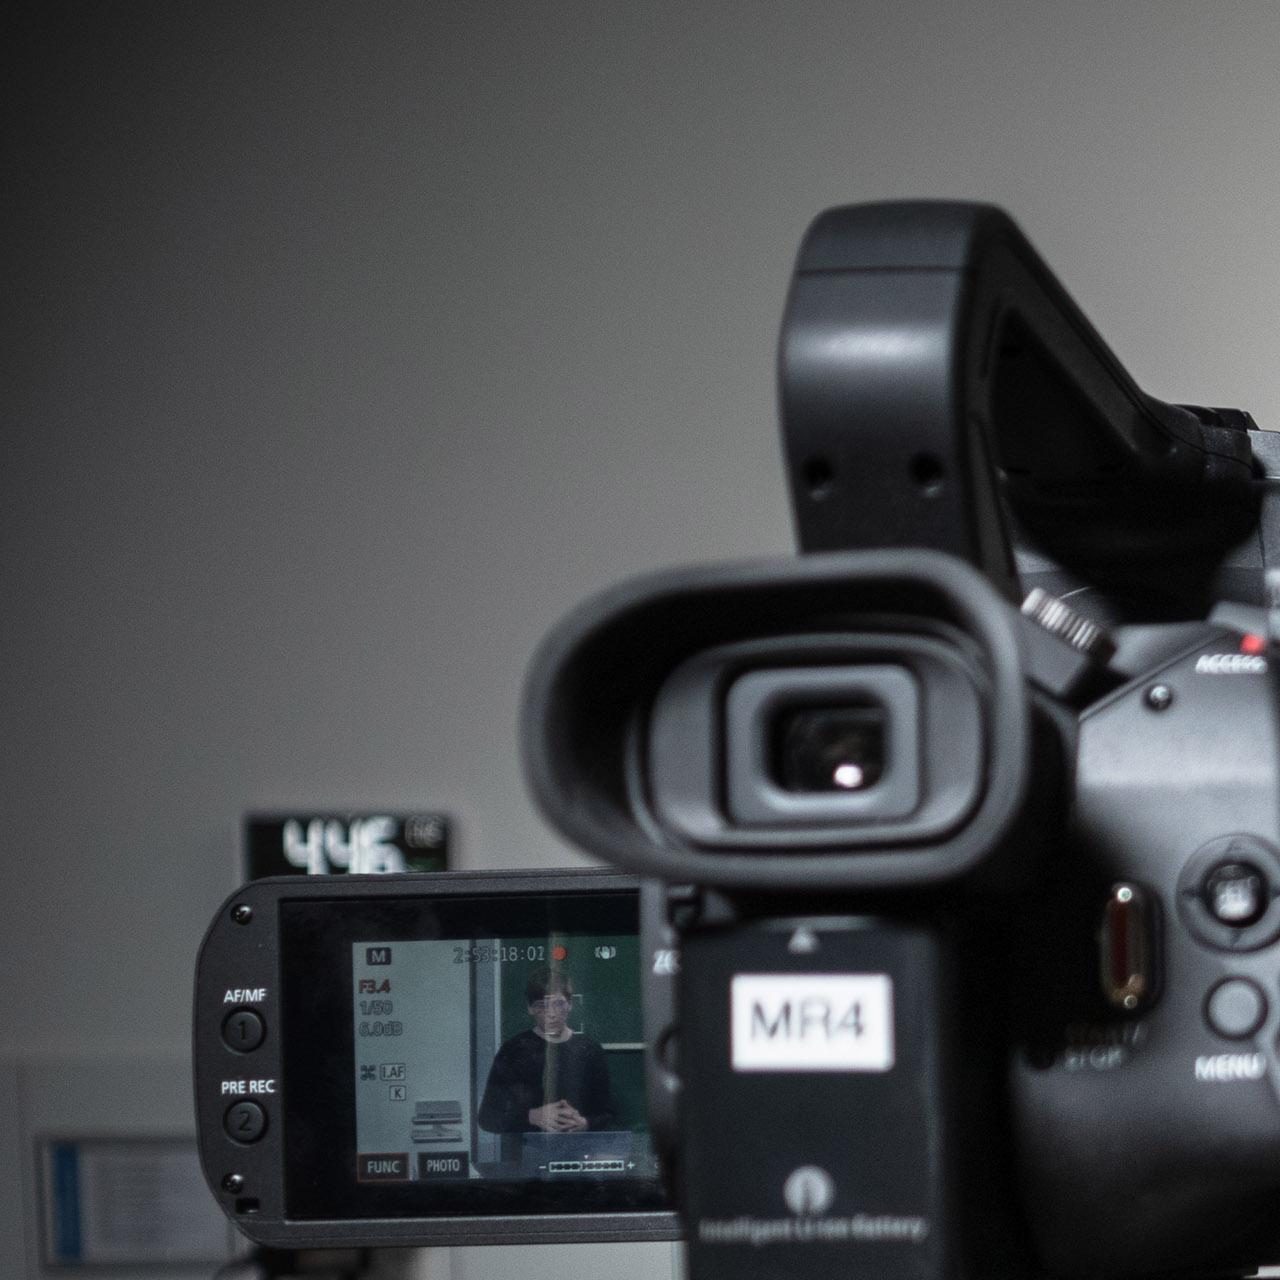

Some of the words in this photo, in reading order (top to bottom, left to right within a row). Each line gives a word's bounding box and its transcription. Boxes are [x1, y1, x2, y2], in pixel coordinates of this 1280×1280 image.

[372, 950, 386, 963] M
[358, 979, 391, 994] F3.4
[223, 988, 266, 1003] AF/MF
[359, 1000, 393, 1015] 1/50
[751, 998, 867, 1043] MR4
[358, 1021, 403, 1036] 6.0dB
[1195, 1053, 1267, 1081] MENU
[221, 1081, 246, 1095] PRE
[249, 1079, 276, 1093] REC
[367, 1160, 400, 1173] FUNC
[427, 1159, 460, 1172] PHOTO
